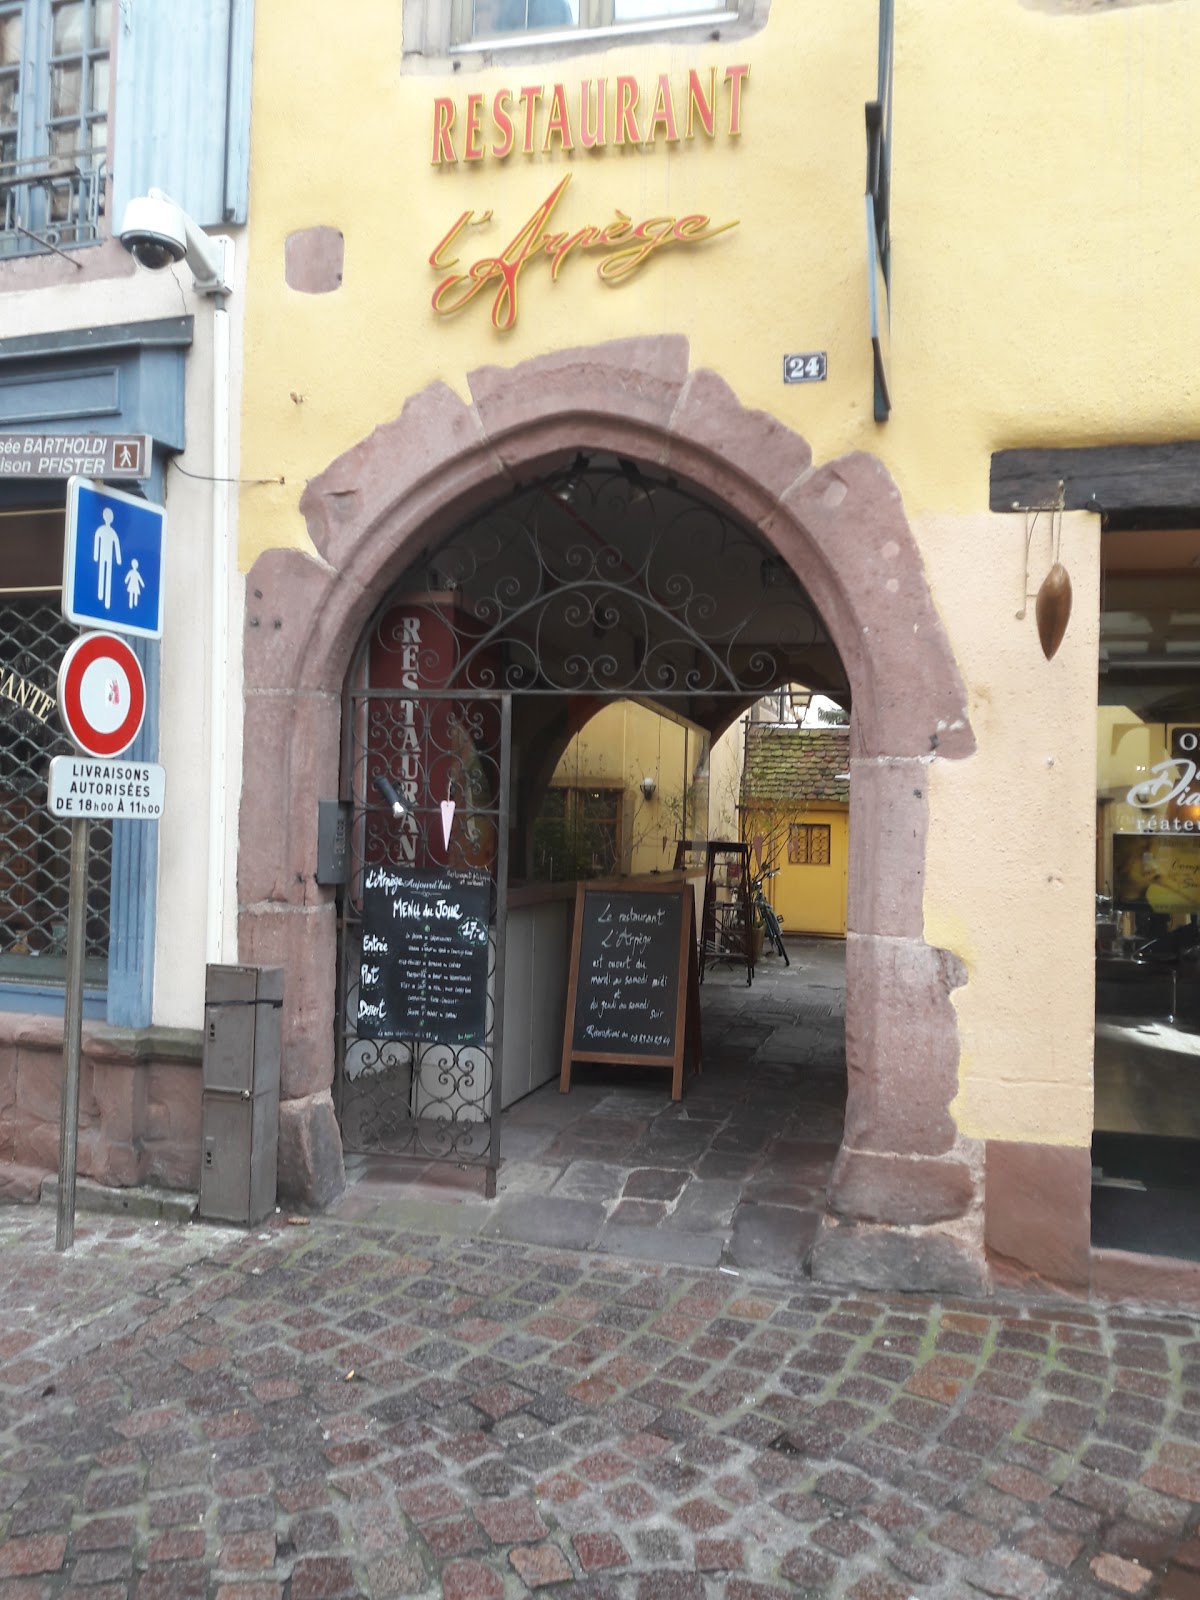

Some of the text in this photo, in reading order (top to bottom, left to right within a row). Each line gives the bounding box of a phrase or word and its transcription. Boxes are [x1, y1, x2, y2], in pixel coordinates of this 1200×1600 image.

[431, 63, 751, 166] RESTAURANT
[789, 355, 820, 378] 24
[23, 438, 108, 455] BARTHOLDI
[38, 457, 106, 475] PFISTER
[0, 667, 57, 724] ANTE
[397, 617, 421, 867] RESTAURAN
[73, 764, 150, 781] LIVRAISONS
[70, 781, 150, 798] AUTORISÉES
[56, 797, 160, 814] DE 18h00 À 11h00
[403, 878, 451, 892] Aujourd'hui
[598, 903, 665, 925] Le restaurant
[593, 954, 647, 969] est ouvert du
[361, 964, 379, 985] Plat
[591, 972, 610, 986] mardi
[625, 973, 648, 985] samedi
[652, 975, 667, 988] midi
[614, 989, 621, 999] et
[629, 999, 649, 1009] samedi
